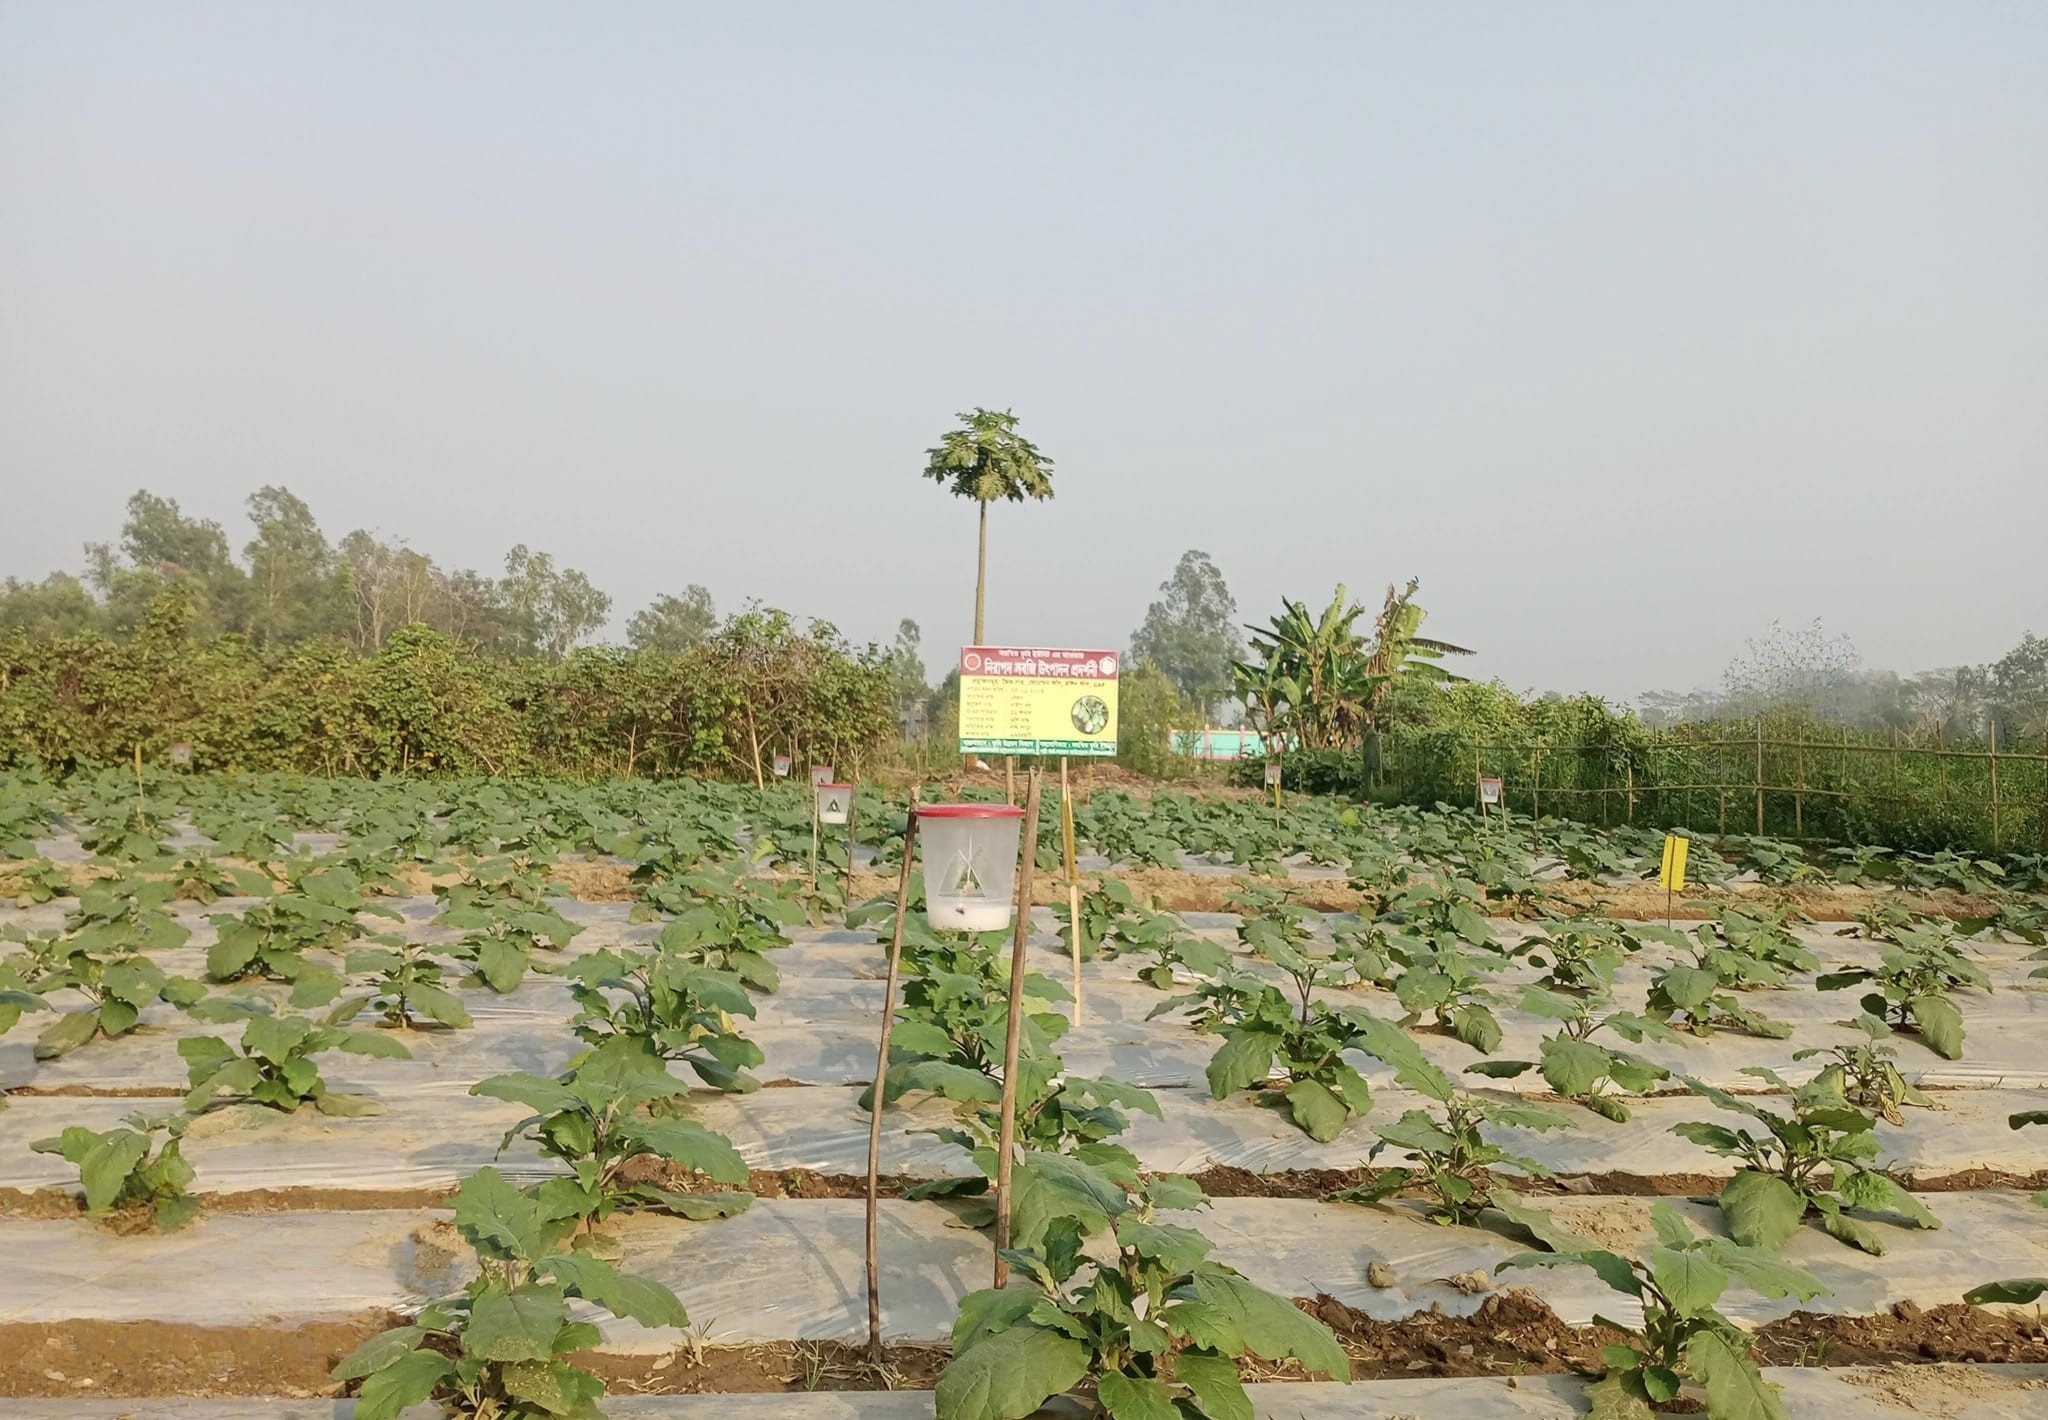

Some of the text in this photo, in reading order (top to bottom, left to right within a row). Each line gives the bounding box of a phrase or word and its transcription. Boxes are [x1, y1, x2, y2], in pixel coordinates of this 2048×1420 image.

[984, 657, 1098, 678] নিরাপদ সবজি উৎপাদন প্রদর্শনী
